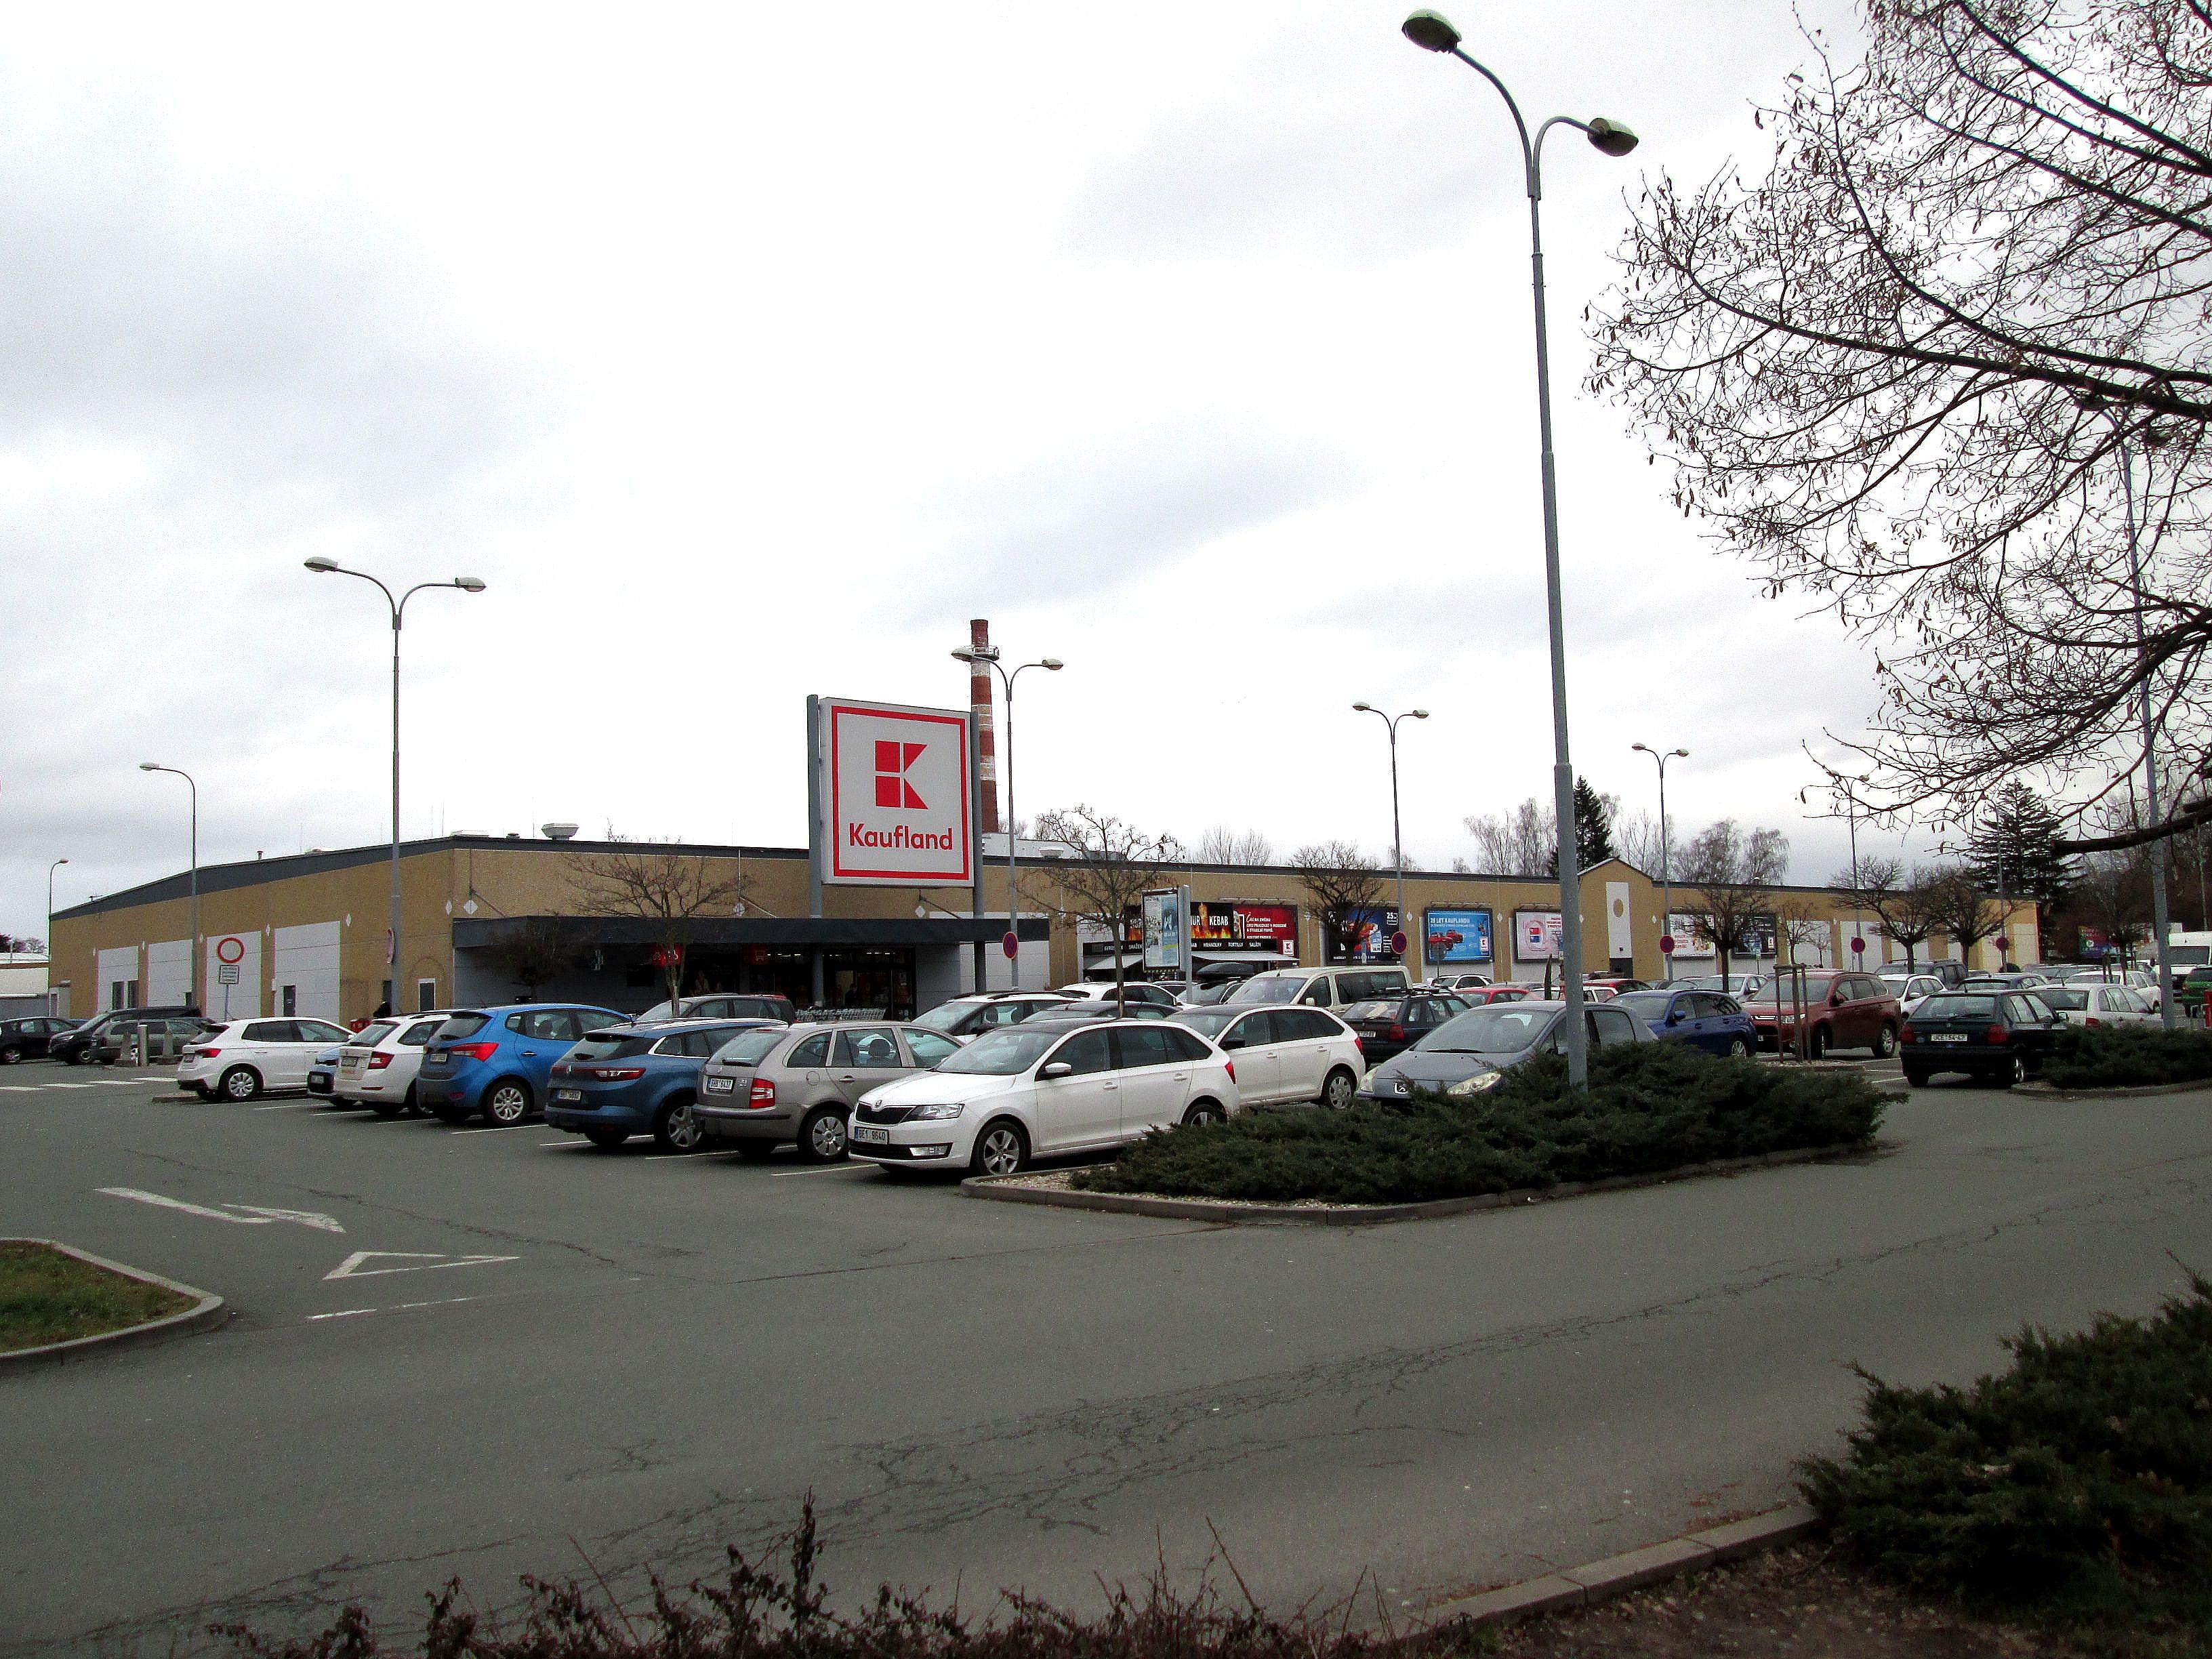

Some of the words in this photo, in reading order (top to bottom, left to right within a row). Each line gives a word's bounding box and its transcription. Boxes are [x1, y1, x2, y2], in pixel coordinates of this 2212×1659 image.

[875, 740, 928, 810] K
[849, 823, 953, 850] Kaufland
[1210, 916, 1229, 926] KEBAB
